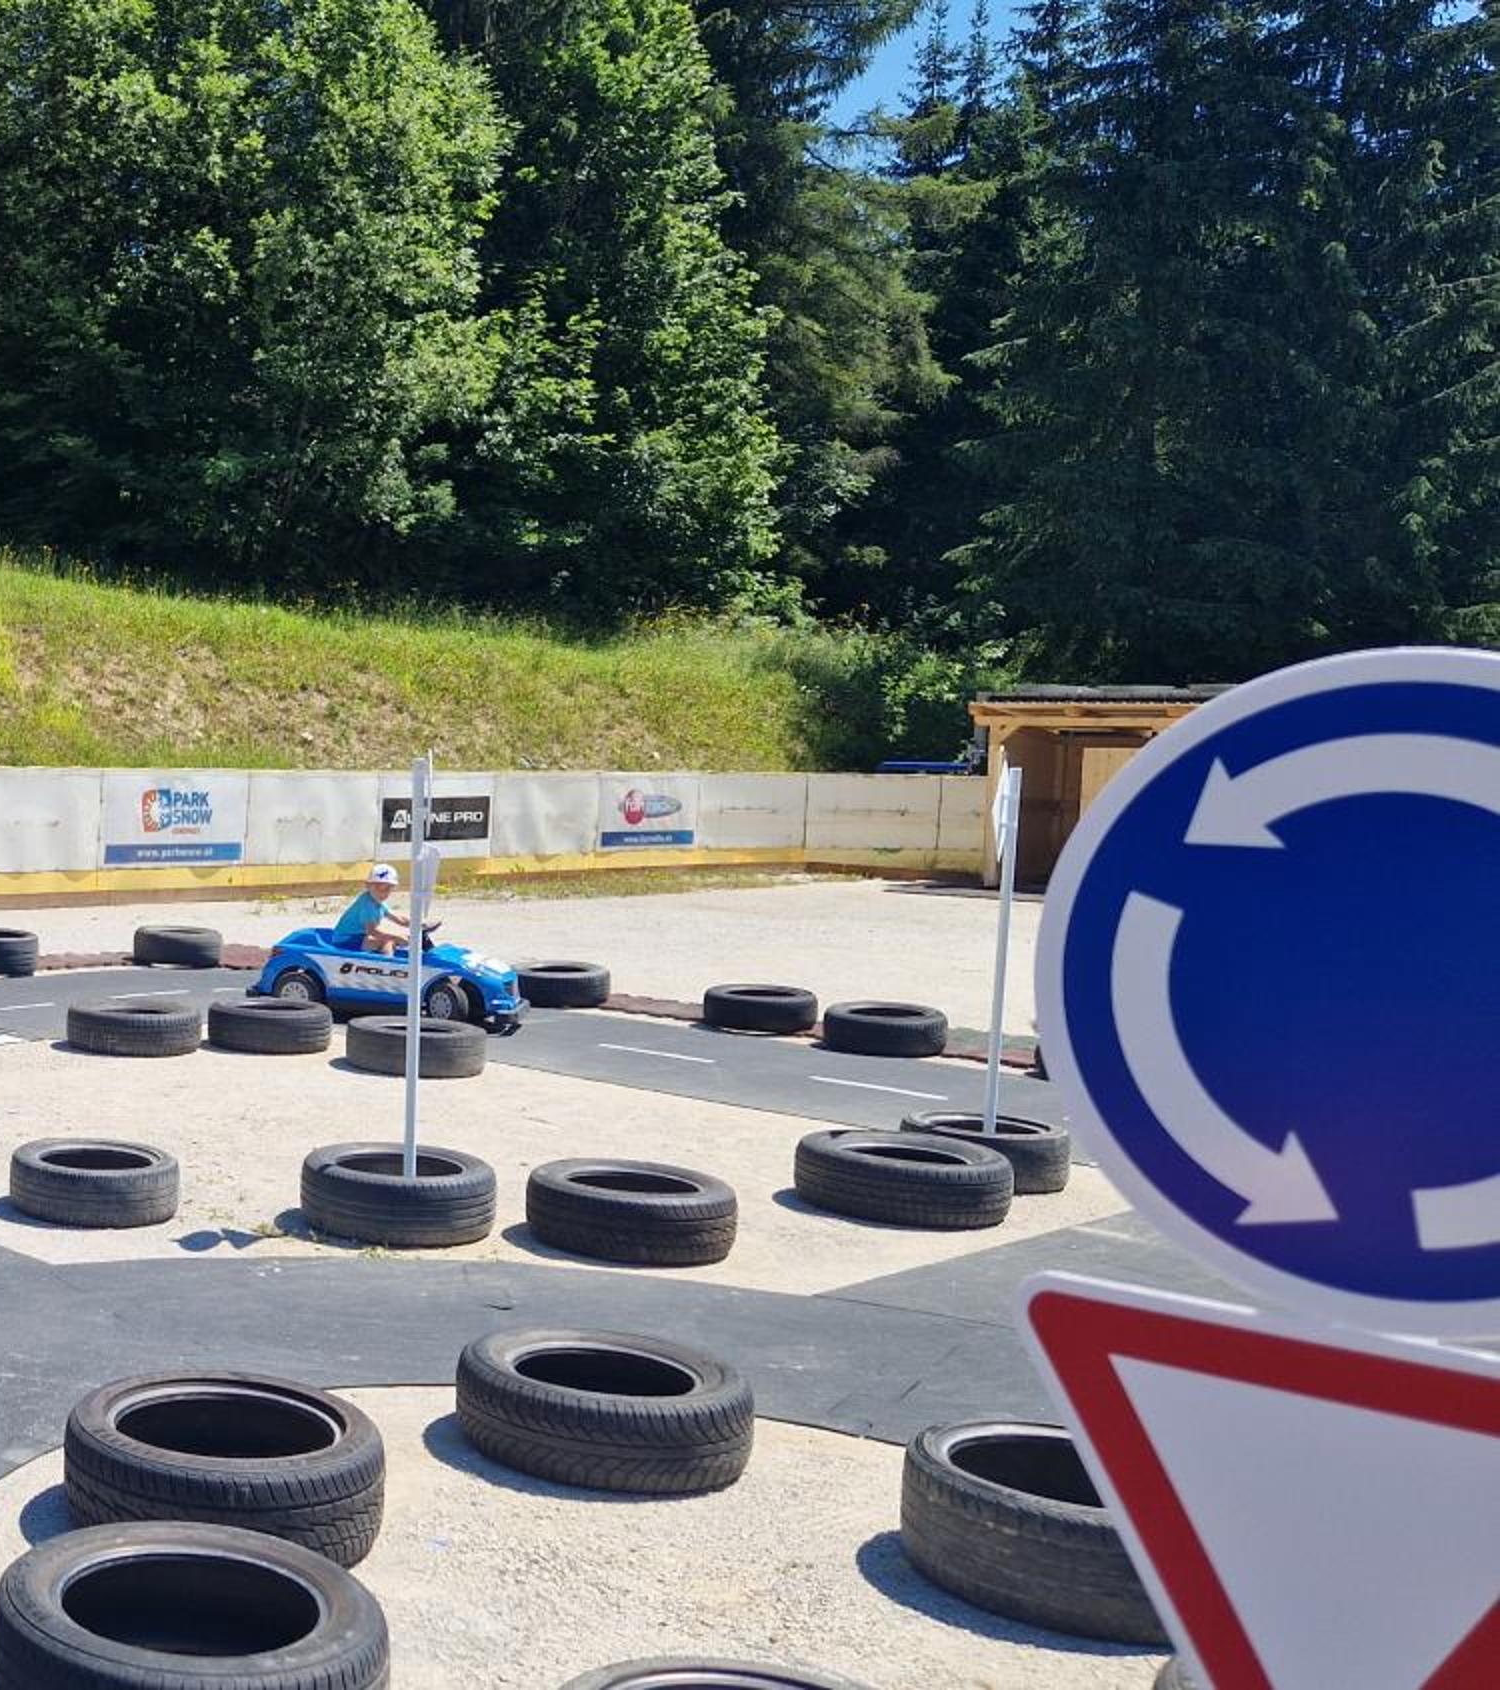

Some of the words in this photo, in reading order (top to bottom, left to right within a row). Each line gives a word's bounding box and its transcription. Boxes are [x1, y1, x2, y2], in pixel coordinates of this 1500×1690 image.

[173, 791, 209, 806] PARK
[172, 809, 213, 824] SNOW
[453, 811, 484, 822] PRO
[355, 965, 409, 979] POLIC
